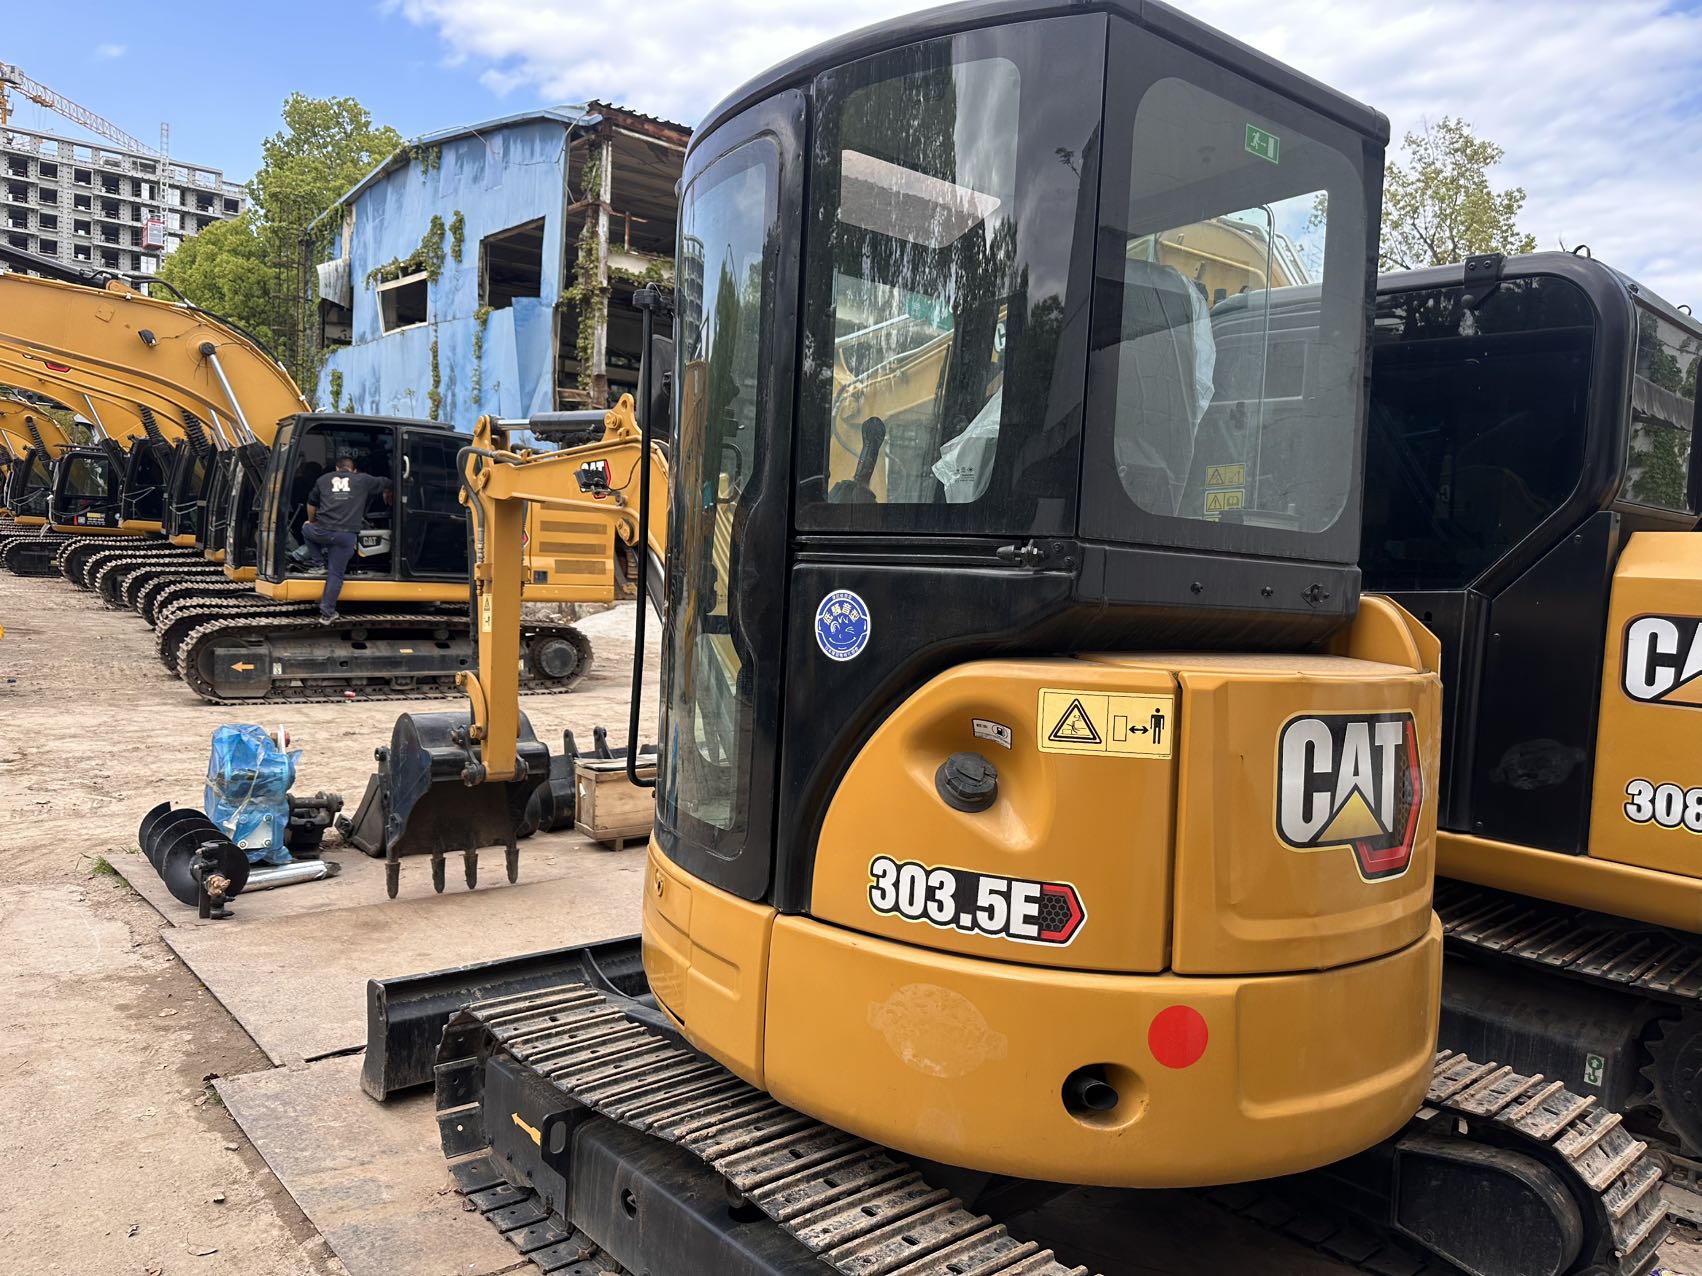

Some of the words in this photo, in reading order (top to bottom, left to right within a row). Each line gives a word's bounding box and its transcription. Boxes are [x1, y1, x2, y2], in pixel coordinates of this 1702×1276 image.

[331, 476, 351, 492] M
[363, 536, 377, 546] CAT
[1625, 617, 1702, 700] C
[1281, 718, 1403, 843] CAT
[871, 858, 1041, 938] 303.5E
